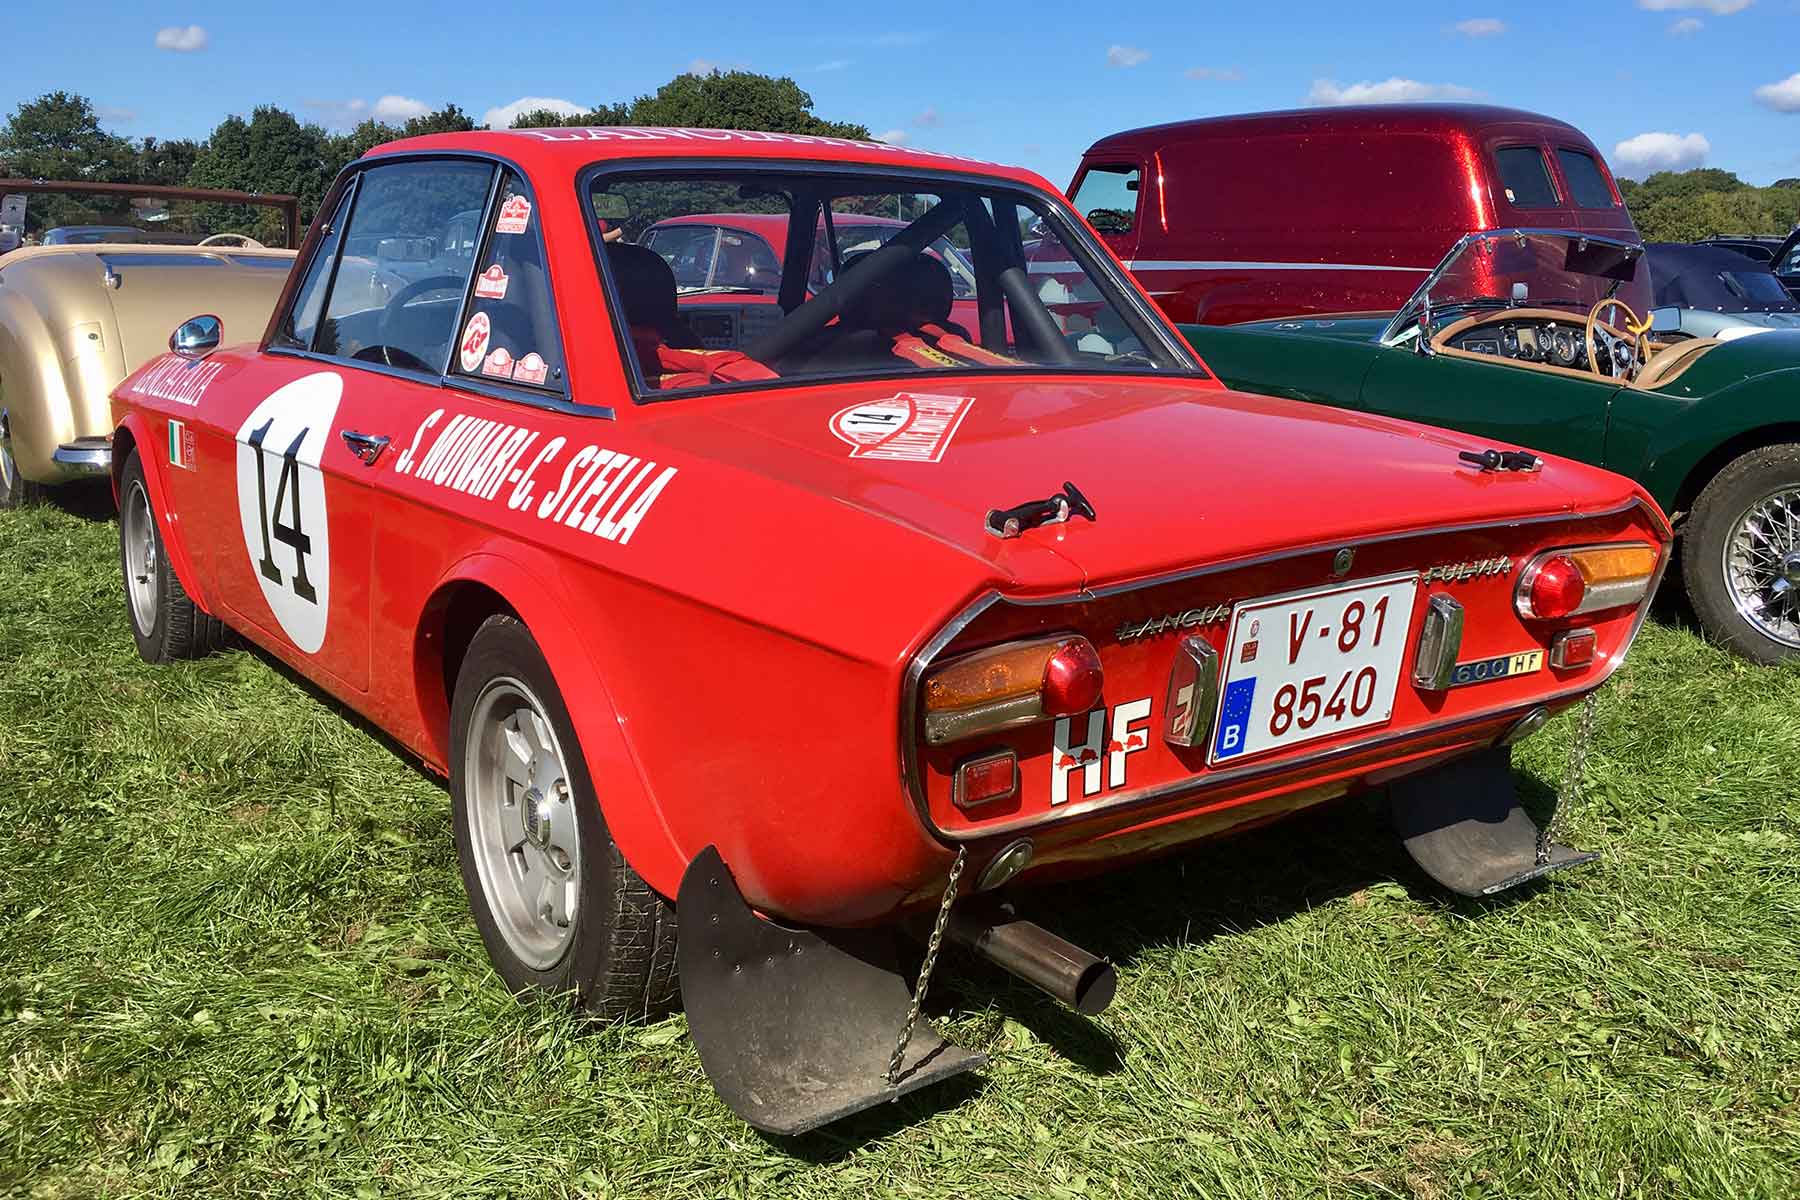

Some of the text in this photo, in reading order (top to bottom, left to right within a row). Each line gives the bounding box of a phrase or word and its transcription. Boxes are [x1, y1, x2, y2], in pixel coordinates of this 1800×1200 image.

[848, 412, 902, 426] 14
[395, 408, 445, 474] S.
[537, 445, 679, 545] STELLA
[247, 417, 319, 606] 14
[1423, 555, 1513, 586] FULVIA
[1117, 603, 1231, 640] LANCIA
[1269, 666, 1378, 737] 8540
[1051, 697, 1152, 806] HF
[1222, 724, 1241, 751] B
